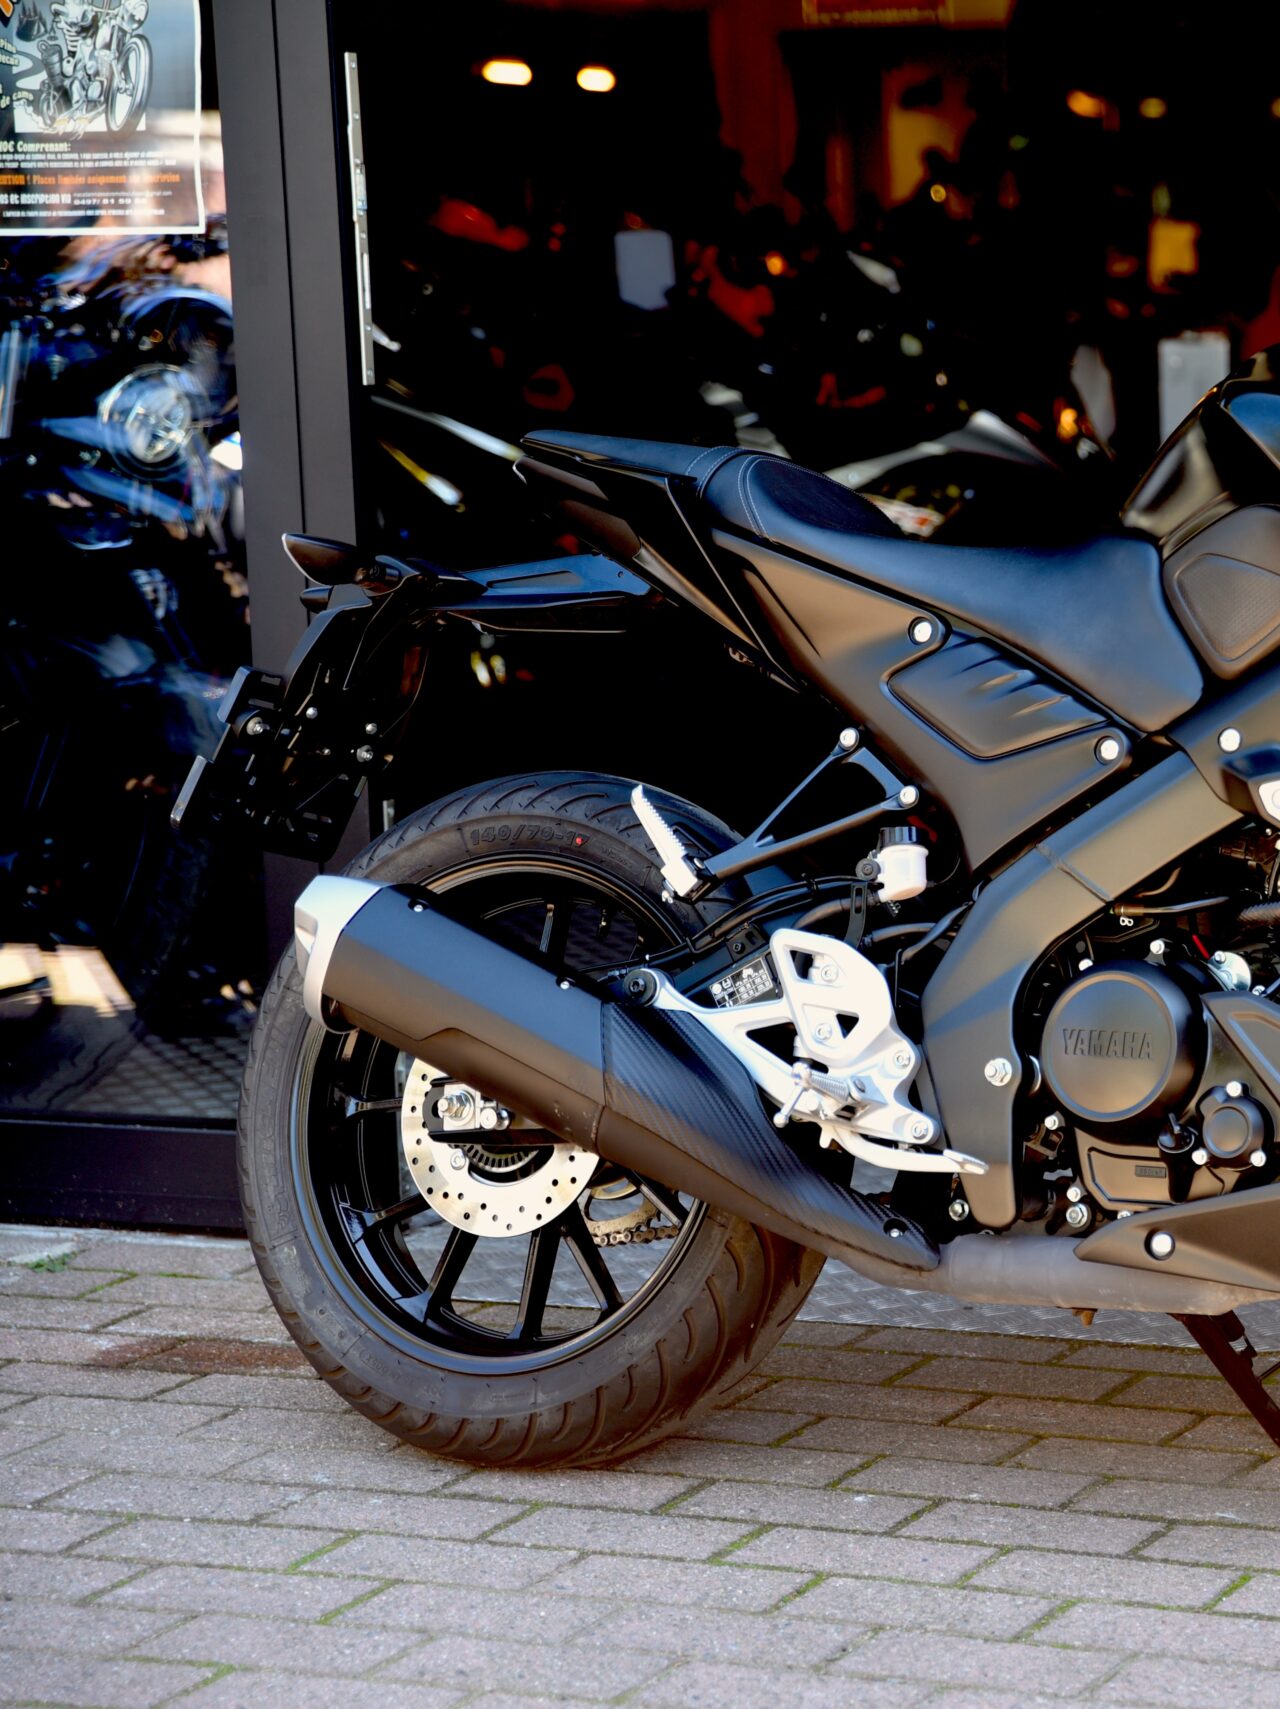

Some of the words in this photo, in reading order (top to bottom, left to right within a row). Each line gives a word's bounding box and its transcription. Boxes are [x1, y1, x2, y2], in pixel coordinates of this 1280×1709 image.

[17, 141, 71, 152] Comprenant:
[470, 824, 590, 847] 140/70-17
[1062, 1028, 1153, 1060] YAMAHA
